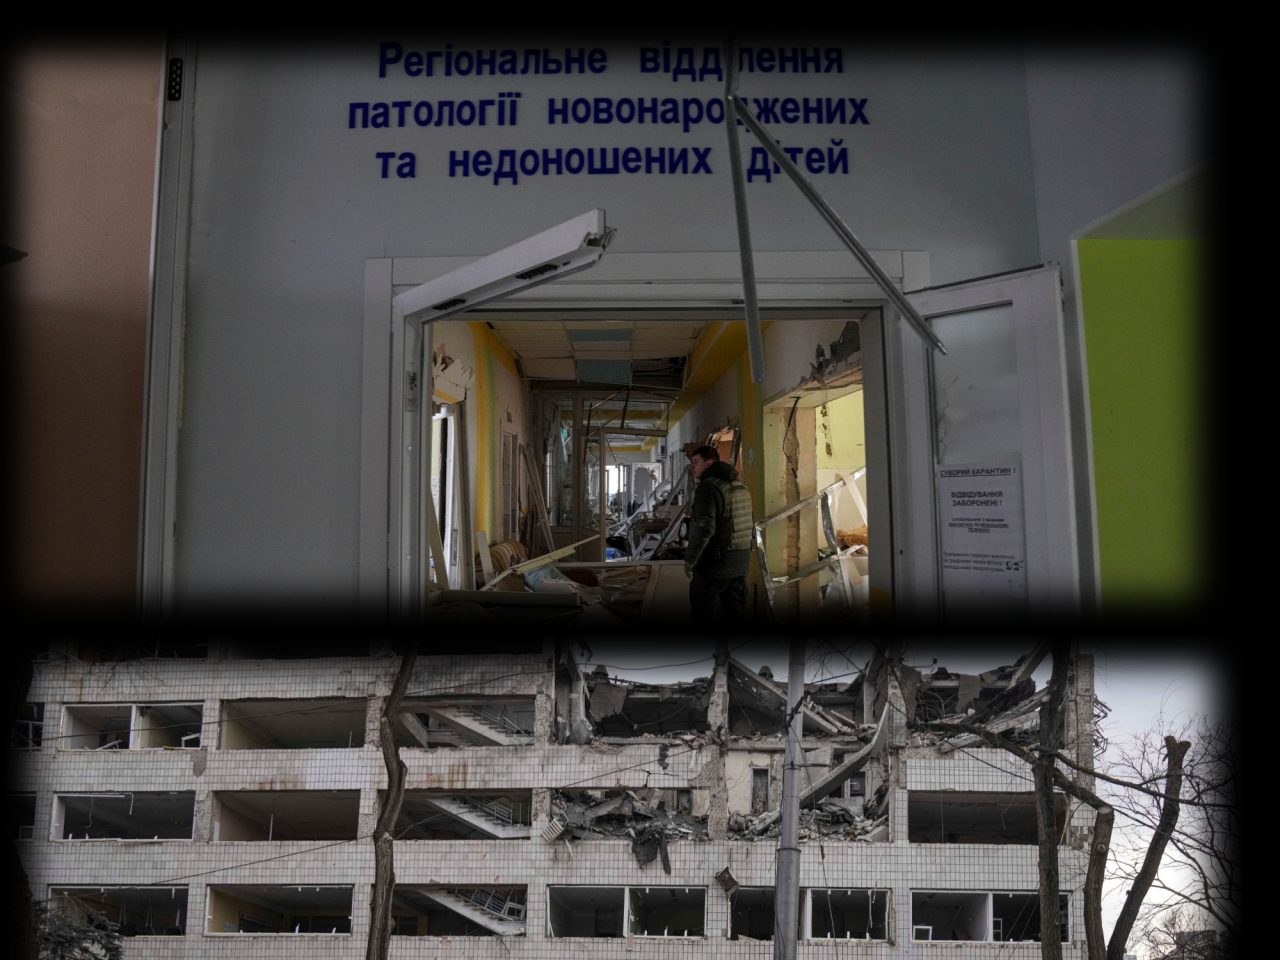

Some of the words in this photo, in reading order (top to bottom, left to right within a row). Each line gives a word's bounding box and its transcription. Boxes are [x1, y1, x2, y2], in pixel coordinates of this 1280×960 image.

[378, 42, 608, 78] Регіональне
[640, 40, 844, 82] віддлення
[348, 92, 522, 129] патології
[375, 151, 416, 179] та
[448, 146, 713, 185] недоношених
